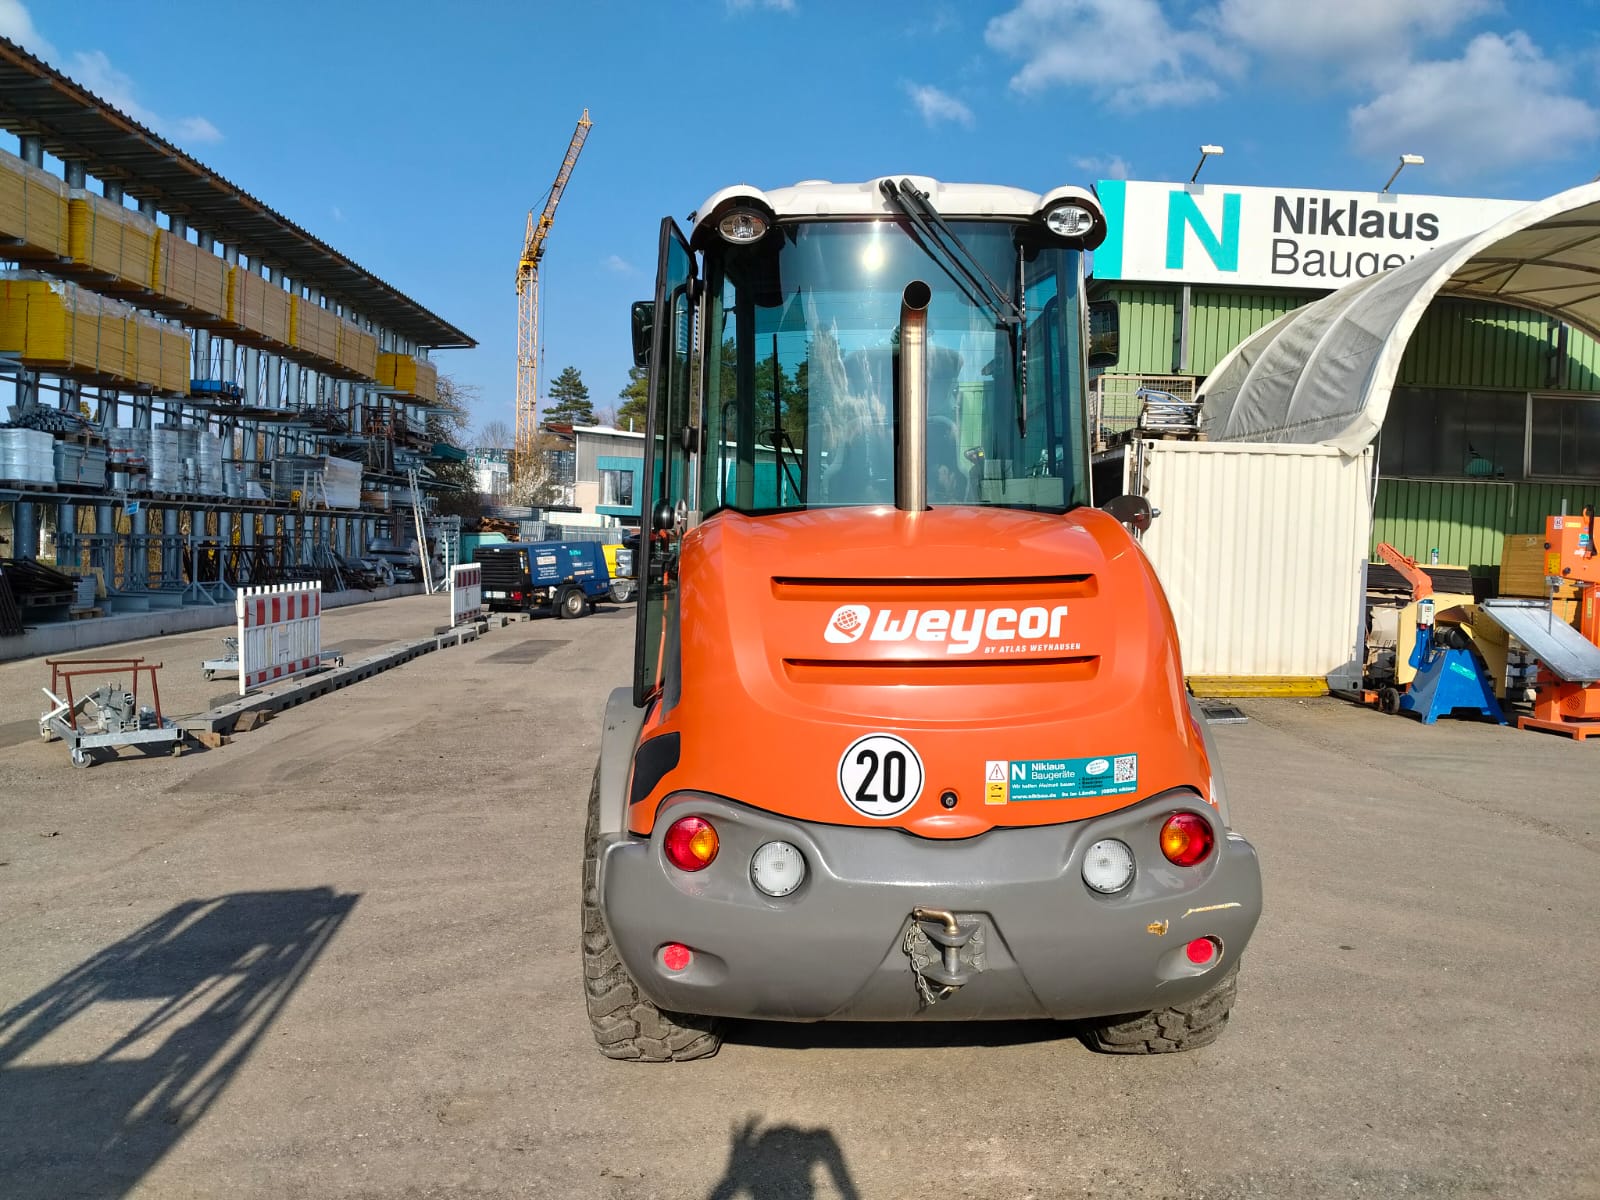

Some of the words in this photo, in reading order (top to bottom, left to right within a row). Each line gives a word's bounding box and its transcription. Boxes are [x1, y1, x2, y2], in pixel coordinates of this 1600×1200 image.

[1165, 190, 1241, 273] N
[1273, 195, 1440, 242] Niklaus
[1271, 238, 1435, 278] Bauge
[869, 606, 1068, 655] weycor
[984, 646, 996, 654] BY
[999, 644, 1027, 653] ATLAS
[1029, 642, 1081, 652] WEYHAUSEN
[855, 749, 906, 803] 20
[1011, 763, 1026, 781] N
[1031, 762, 1065, 771] Niklaus
[1031, 770, 1075, 780] Baugeräte
